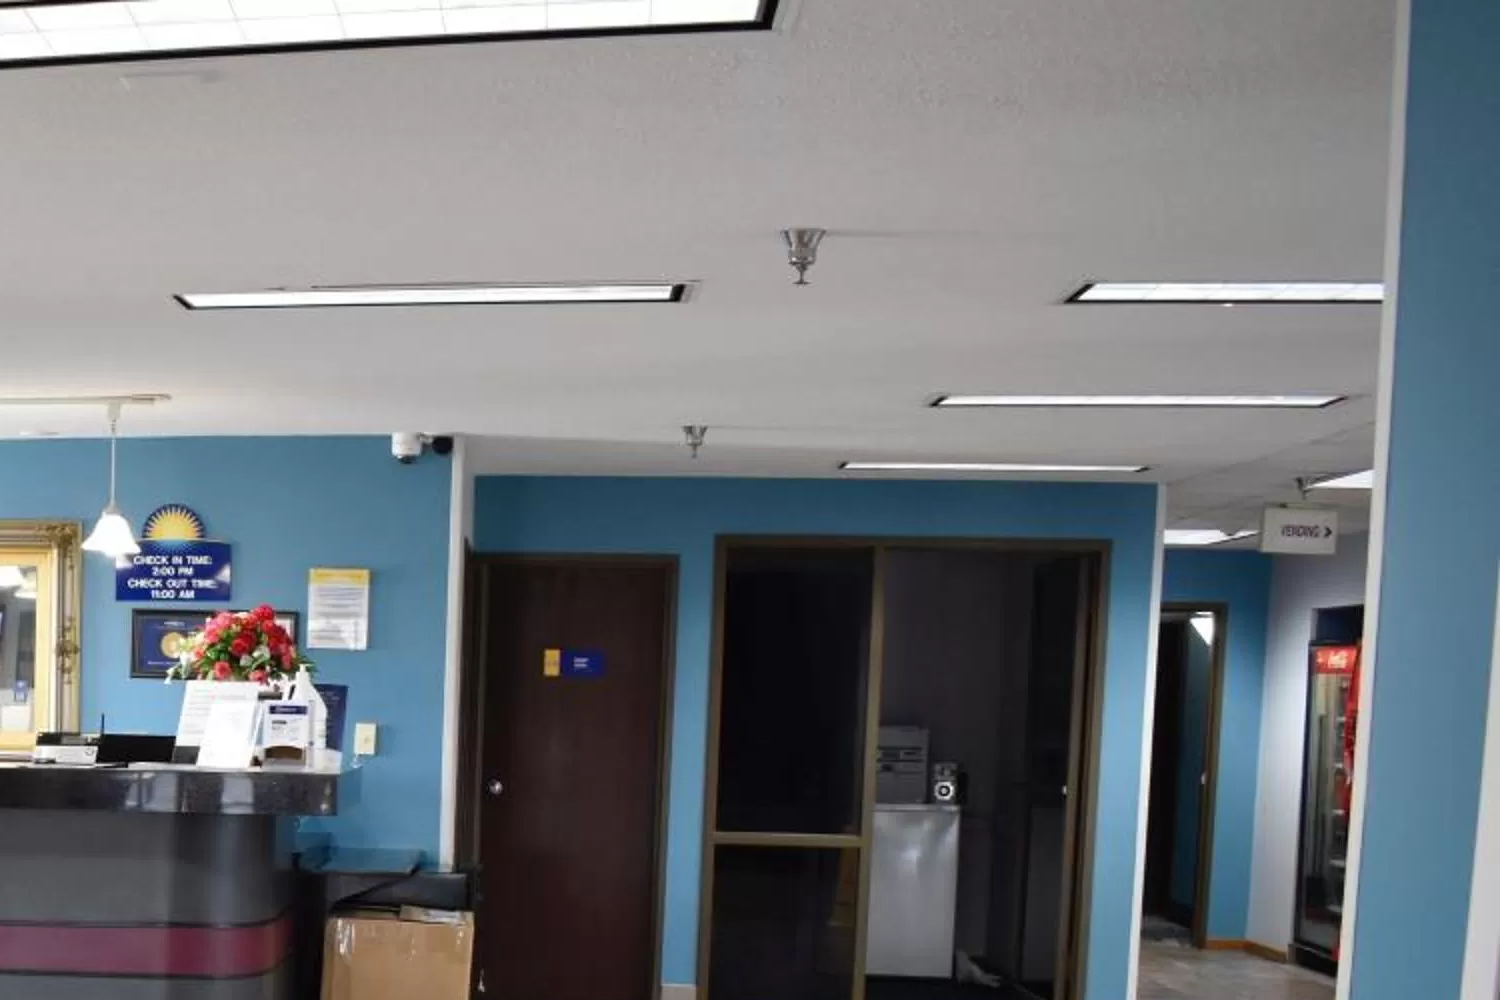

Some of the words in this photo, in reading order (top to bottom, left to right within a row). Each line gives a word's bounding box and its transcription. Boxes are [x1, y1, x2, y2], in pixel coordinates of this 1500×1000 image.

[133, 555, 169, 565] CHECK
[171, 555, 183, 565] IN
[151, 566, 175, 576] 2:00
[177, 566, 194, 576] PM
[127, 578, 163, 589] CHECK
[165, 578, 187, 589] OUT
[178, 589, 195, 599] AM
